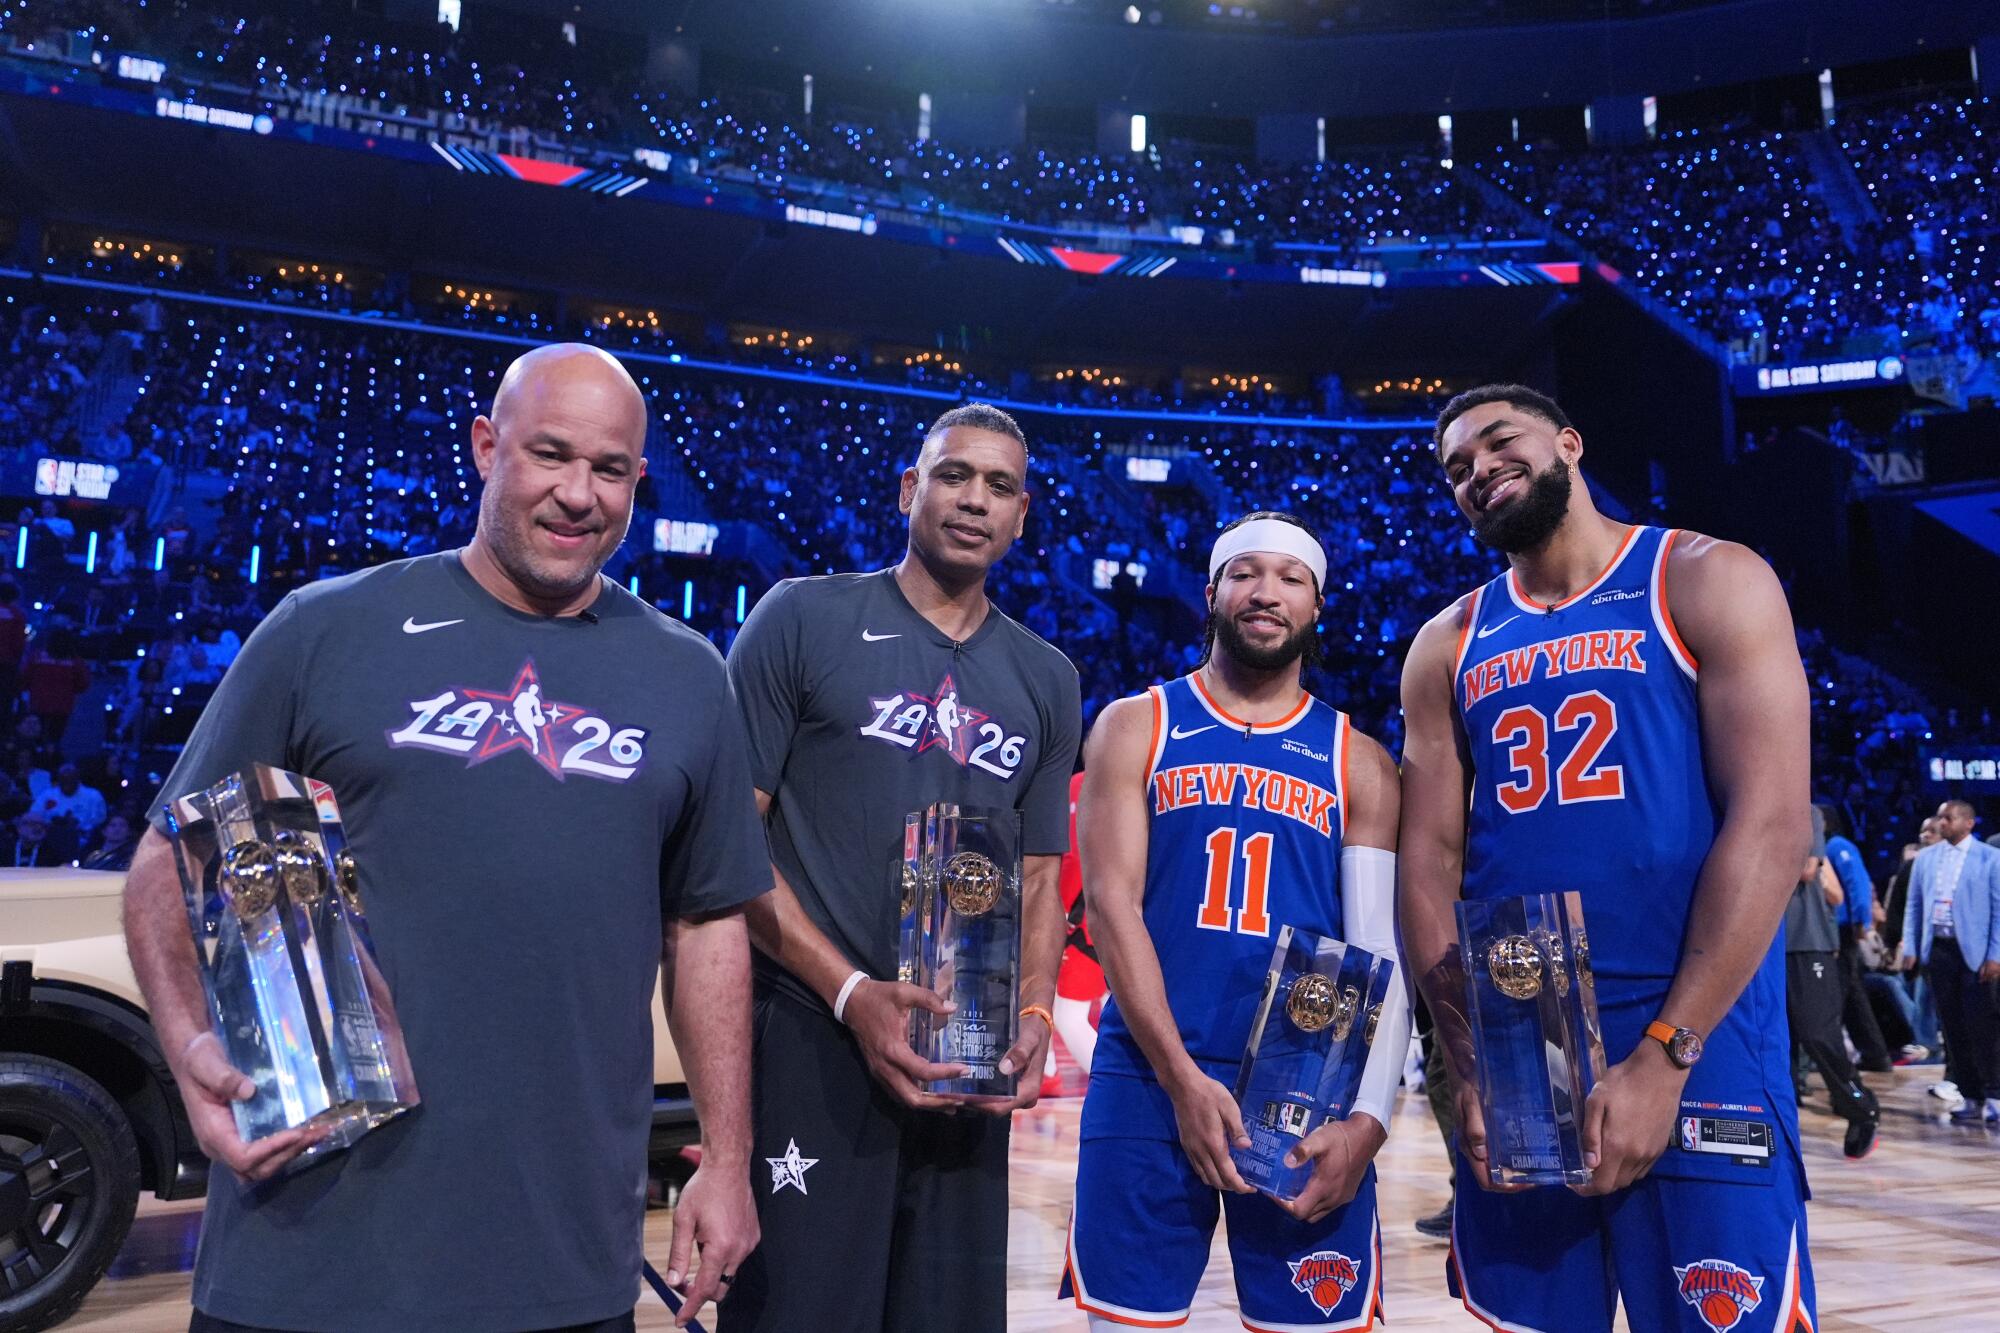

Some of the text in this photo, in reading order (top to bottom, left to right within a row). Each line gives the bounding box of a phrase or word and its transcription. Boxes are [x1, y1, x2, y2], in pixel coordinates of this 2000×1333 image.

[1591, 588, 1646, 605] abu dhabi
[1463, 629, 1647, 712] NEW YORK
[391, 691, 645, 779] LA 26
[860, 694, 1026, 779] LA 26
[1281, 743, 1329, 763] abu dhabi
[1492, 689, 1626, 815] 32
[1154, 763, 1337, 839] NEW YORK
[1196, 826, 1274, 938] 11
[962, 1031, 996, 1046] SHOOTING
[962, 1044, 984, 1057] STARS
[1511, 1154, 1560, 1169] CHAMPIONS
[1295, 1257, 1357, 1284] KNICKS
[1681, 1267, 1759, 1303] KNICKS
